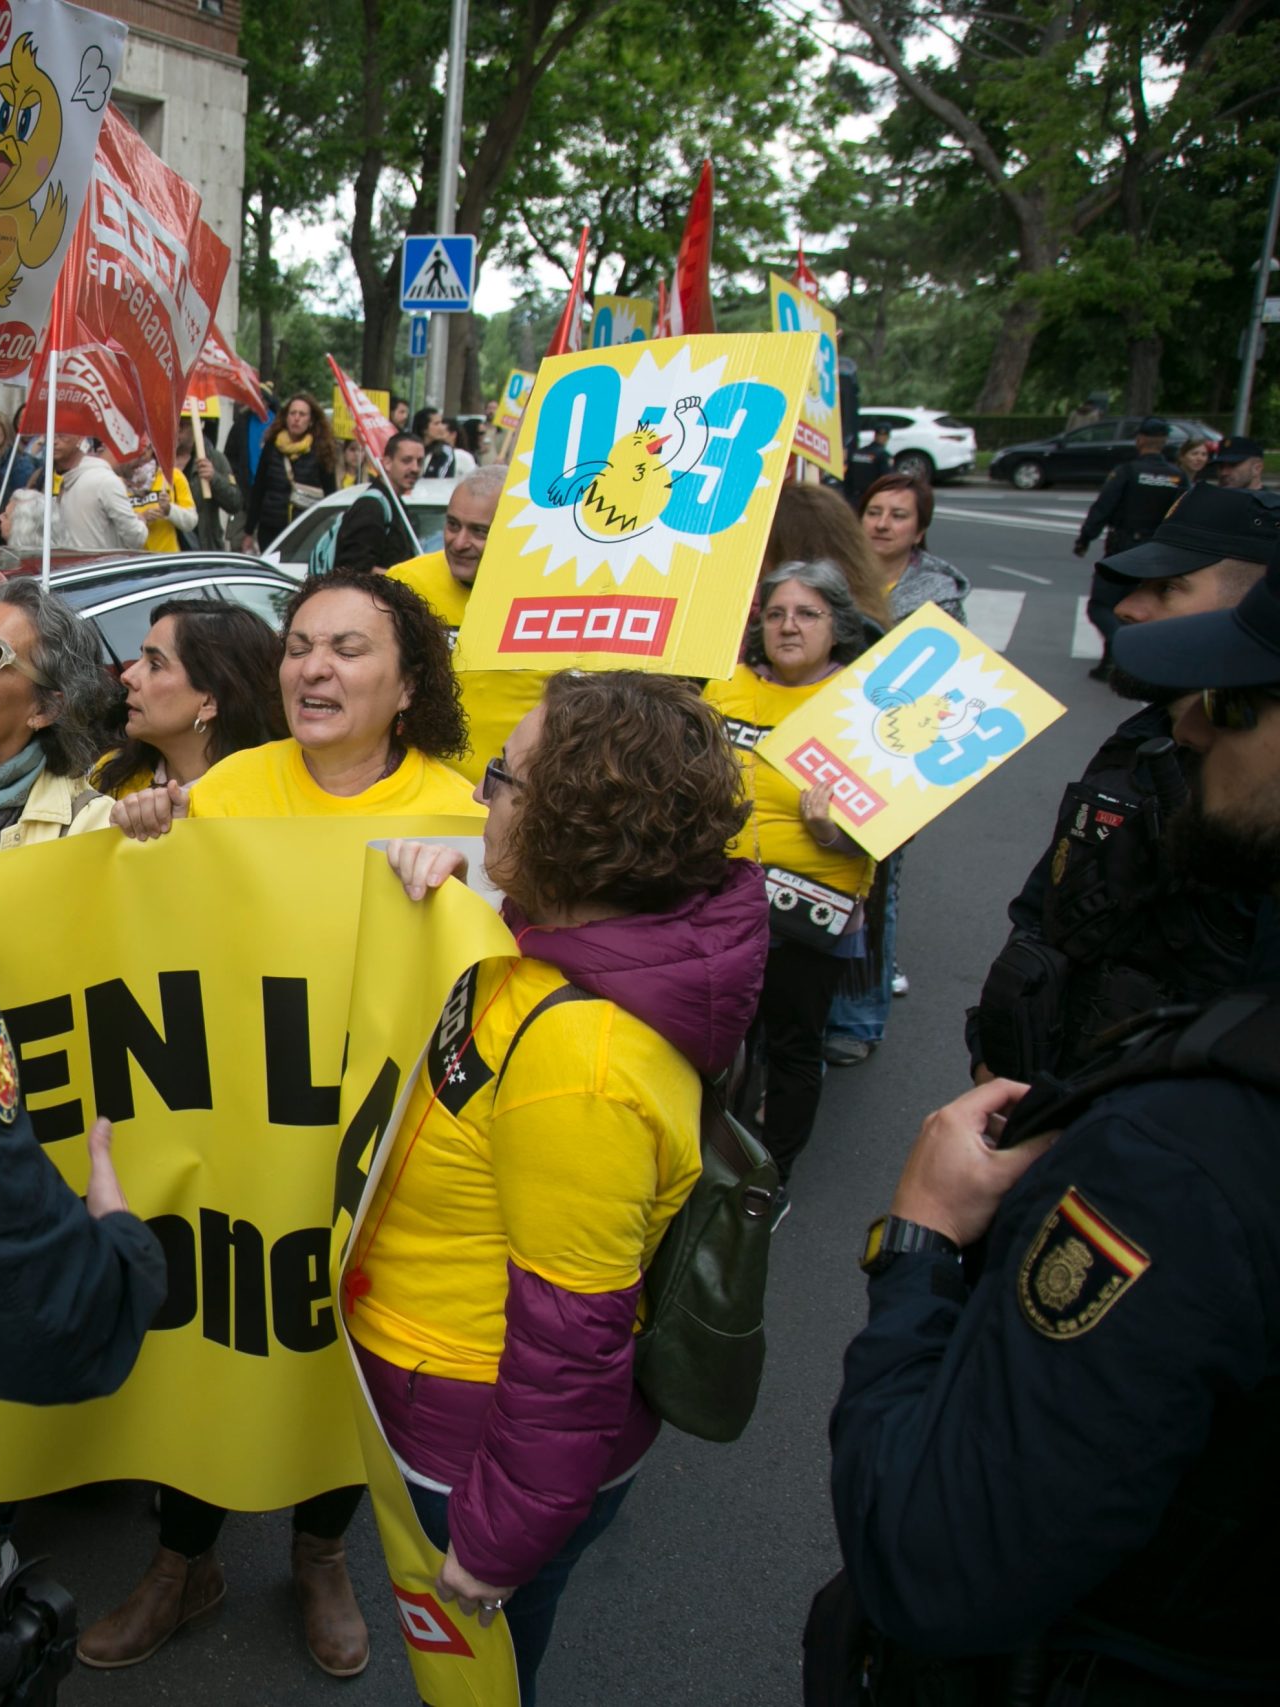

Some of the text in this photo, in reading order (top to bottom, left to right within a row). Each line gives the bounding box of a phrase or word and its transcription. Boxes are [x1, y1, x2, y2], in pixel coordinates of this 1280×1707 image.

[86, 247, 175, 379] enseñanza
[529, 365, 787, 535] 0-3
[513, 608, 660, 642] CCOO
[863, 626, 1026, 787] 0-3
[778, 871, 806, 888] TAPE
[1, 970, 213, 1144] EN
